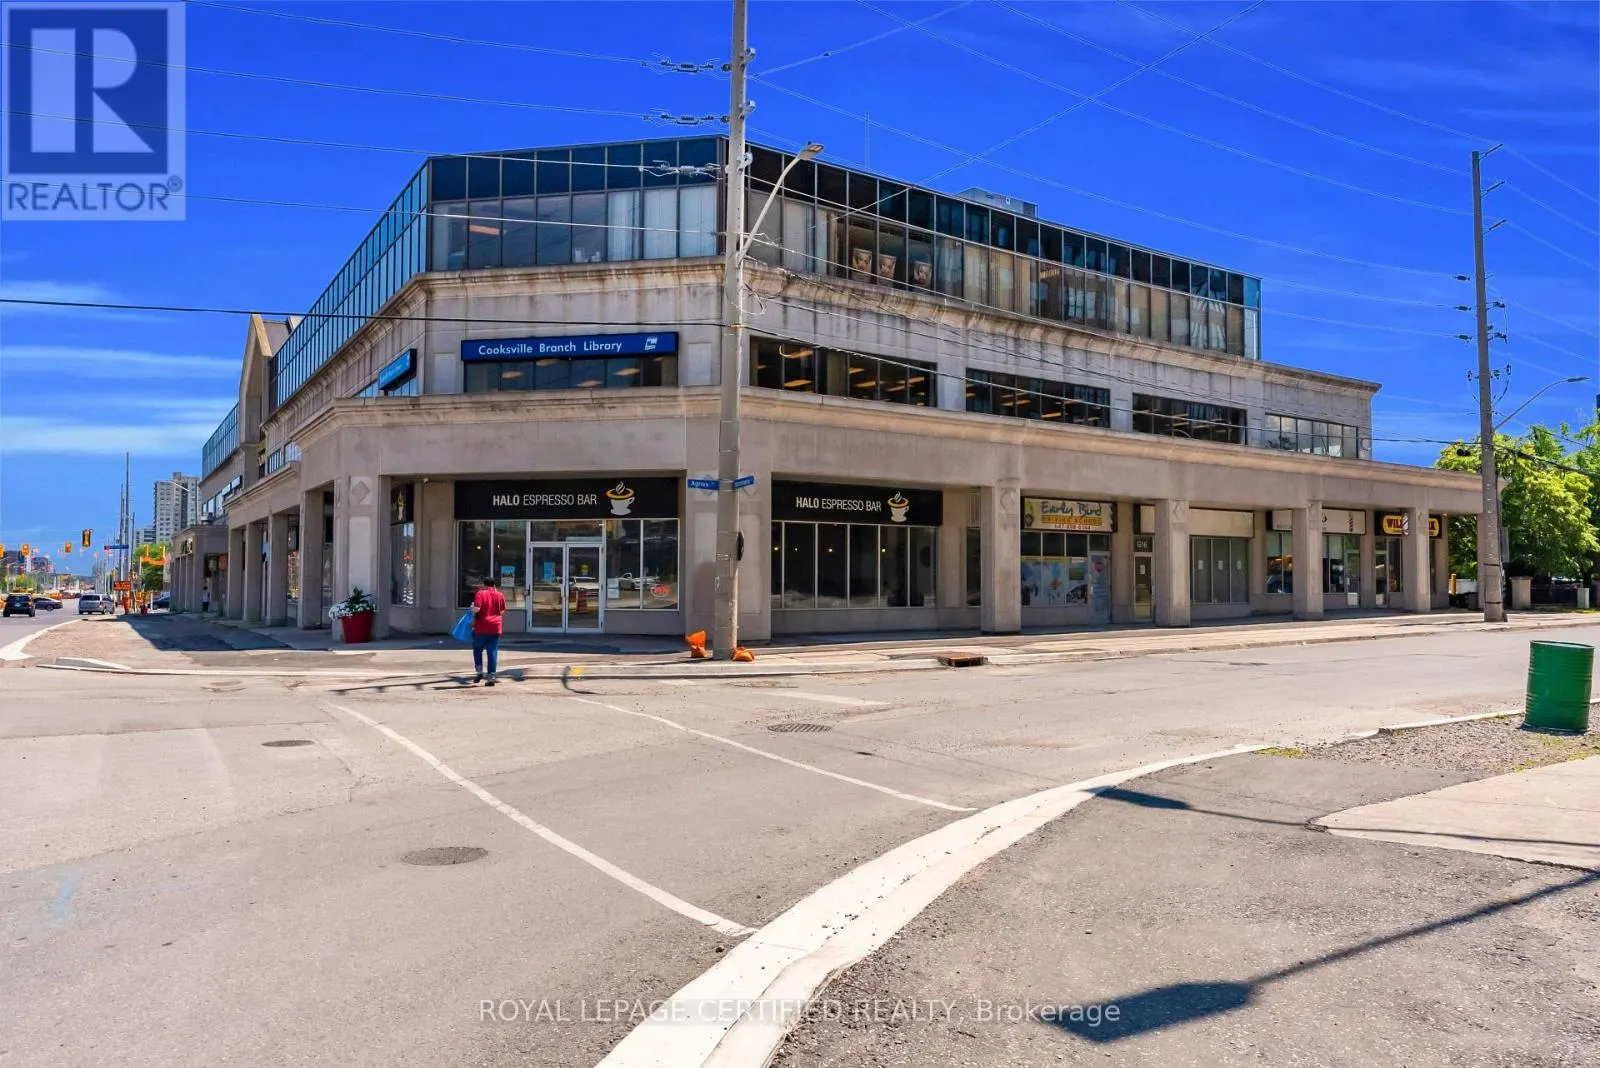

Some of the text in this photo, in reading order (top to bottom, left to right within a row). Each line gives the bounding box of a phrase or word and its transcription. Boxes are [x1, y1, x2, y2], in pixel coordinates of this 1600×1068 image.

[478, 341, 623, 355] Cooksville Branch Library
[493, 494, 598, 506] HALO ESPRESSO BAR
[796, 496, 882, 512] HALO ESPRESSO BAR
[1077, 502, 1102, 517] Bird
